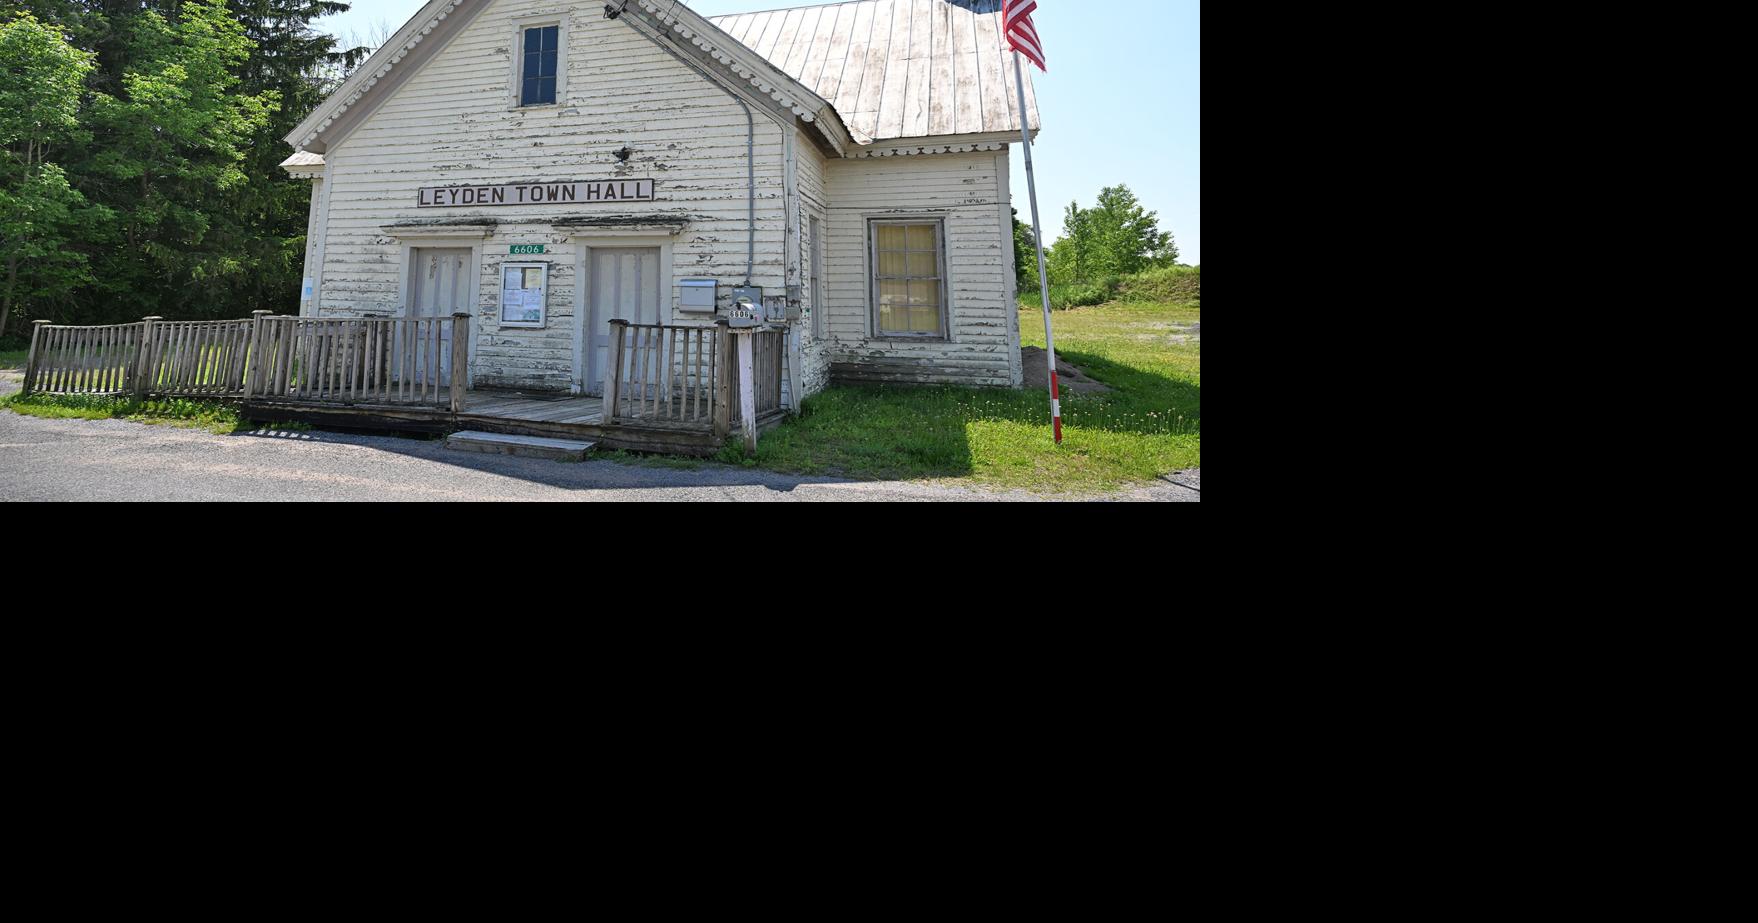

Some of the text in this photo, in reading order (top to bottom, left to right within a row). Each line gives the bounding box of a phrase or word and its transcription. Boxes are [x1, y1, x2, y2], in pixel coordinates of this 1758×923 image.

[420, 182, 650, 205] LEYDEN TOWN HALL
[514, 245, 539, 254] 6606
[729, 310, 749, 318] 6606
